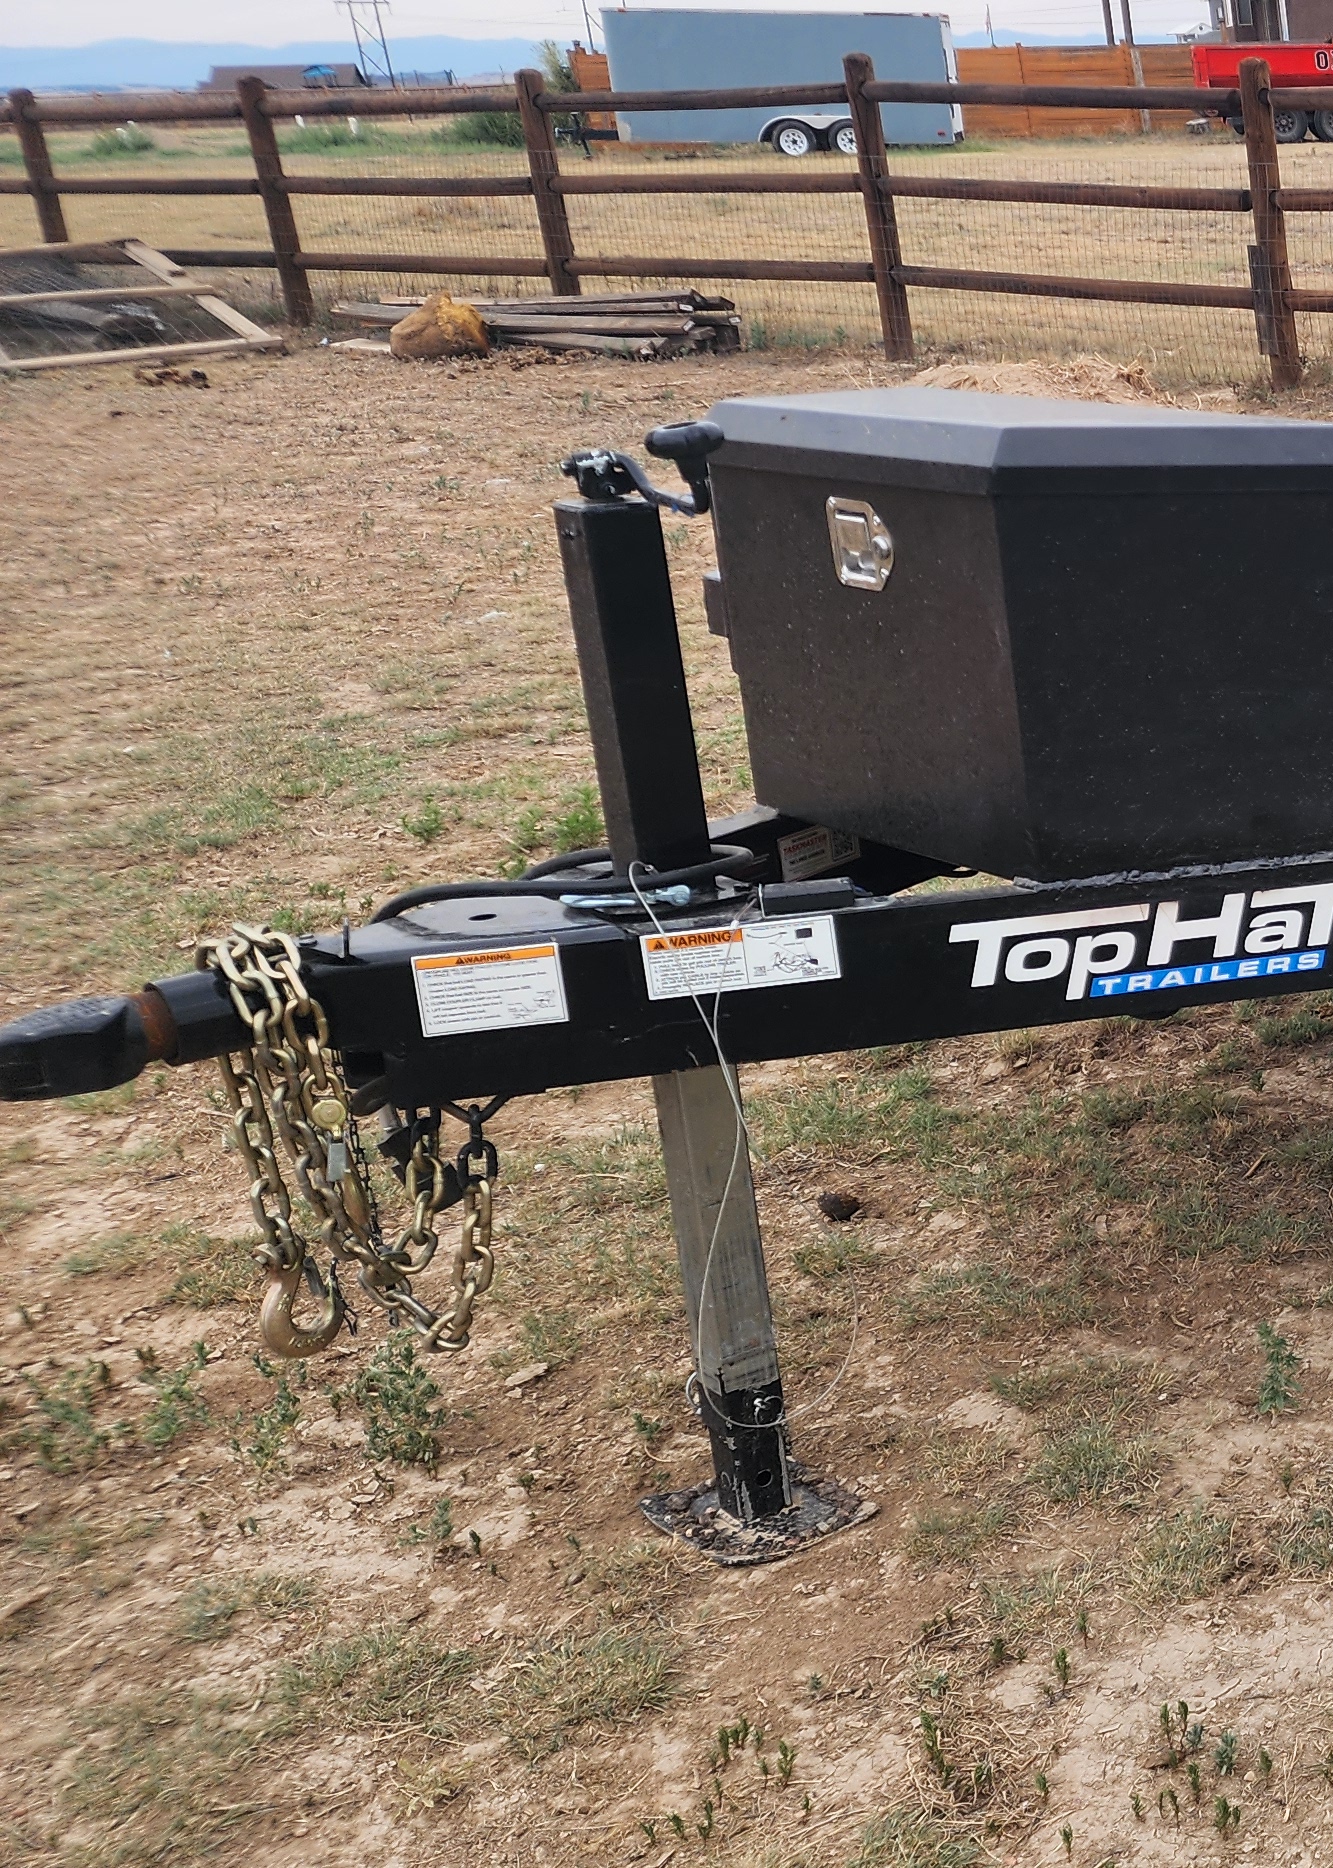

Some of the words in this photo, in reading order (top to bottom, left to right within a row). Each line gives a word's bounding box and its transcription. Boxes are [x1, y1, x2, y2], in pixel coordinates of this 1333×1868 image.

[668, 931, 732, 948] WARNING
[463, 952, 512, 964] WARNING
[1098, 950, 1324, 996] TRAILERS
